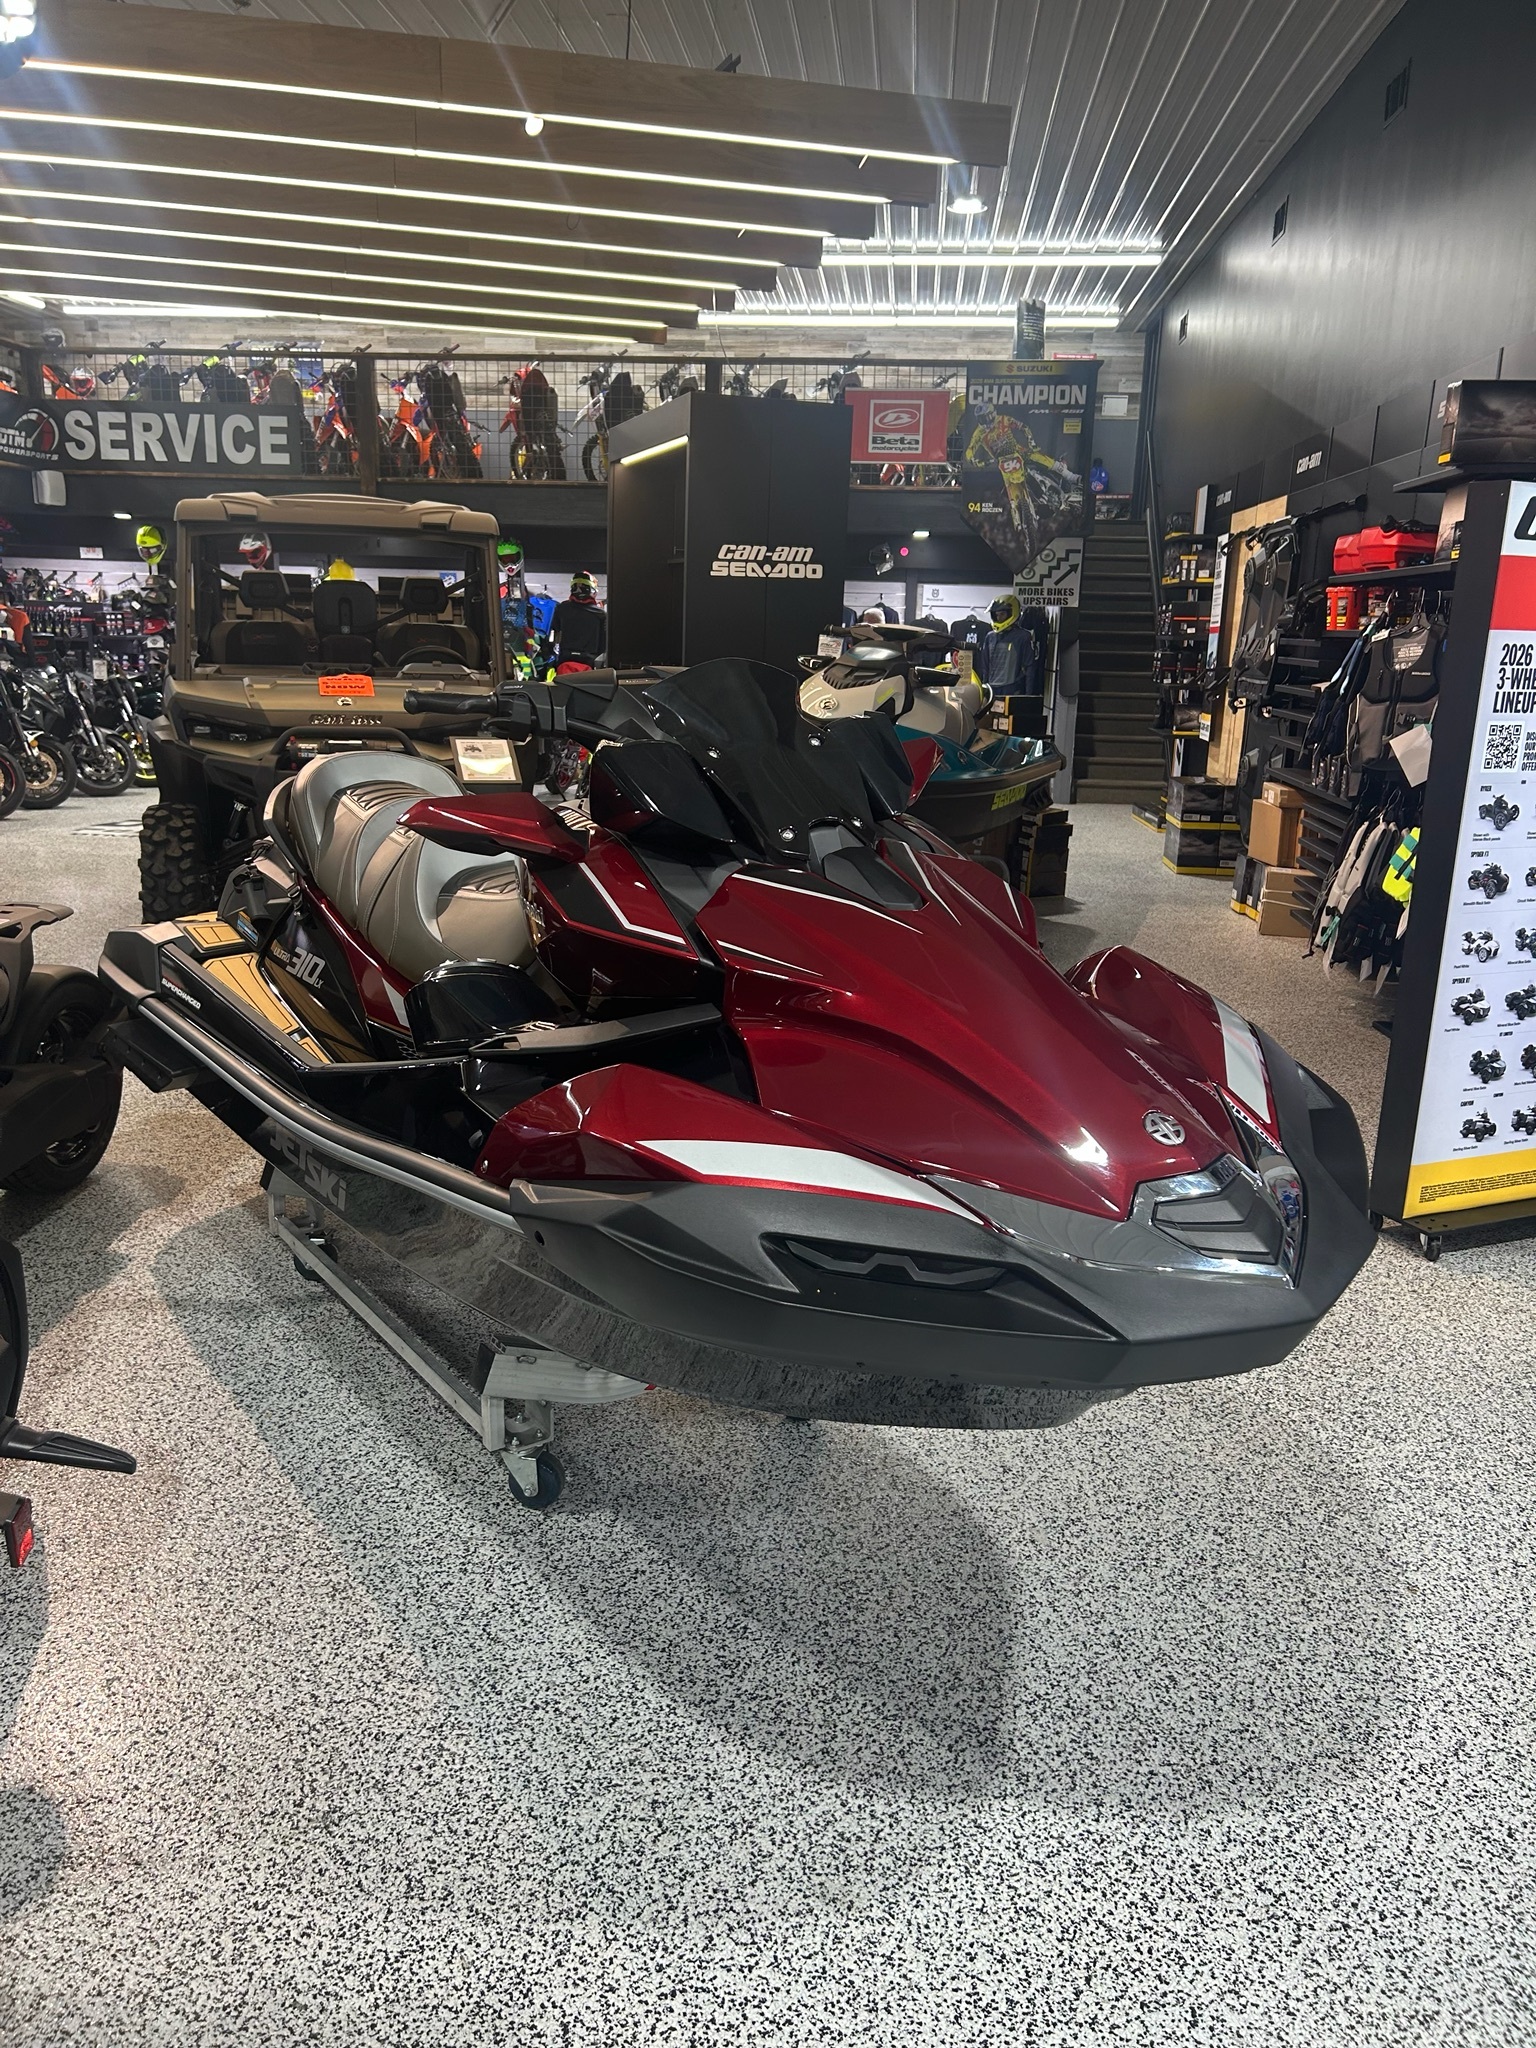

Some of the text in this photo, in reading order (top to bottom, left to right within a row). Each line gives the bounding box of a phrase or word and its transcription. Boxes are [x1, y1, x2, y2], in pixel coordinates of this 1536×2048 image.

[968, 384, 1087, 405] CHAMPION
[64, 410, 291, 465] SERVICE
[871, 435, 920, 446] Beta
[1003, 459, 1020, 472] 94
[968, 502, 981, 513] 94
[1018, 588, 1074, 596] MORE BIKES
[1023, 597, 1069, 606] UPSTAIRS
[1499, 643, 1534, 666] 2026
[1521, 761, 1536, 771] OFFE
[273, 946, 326, 988] ULTRA 310 LX
[161, 977, 202, 1010] SUPERCHARGED
